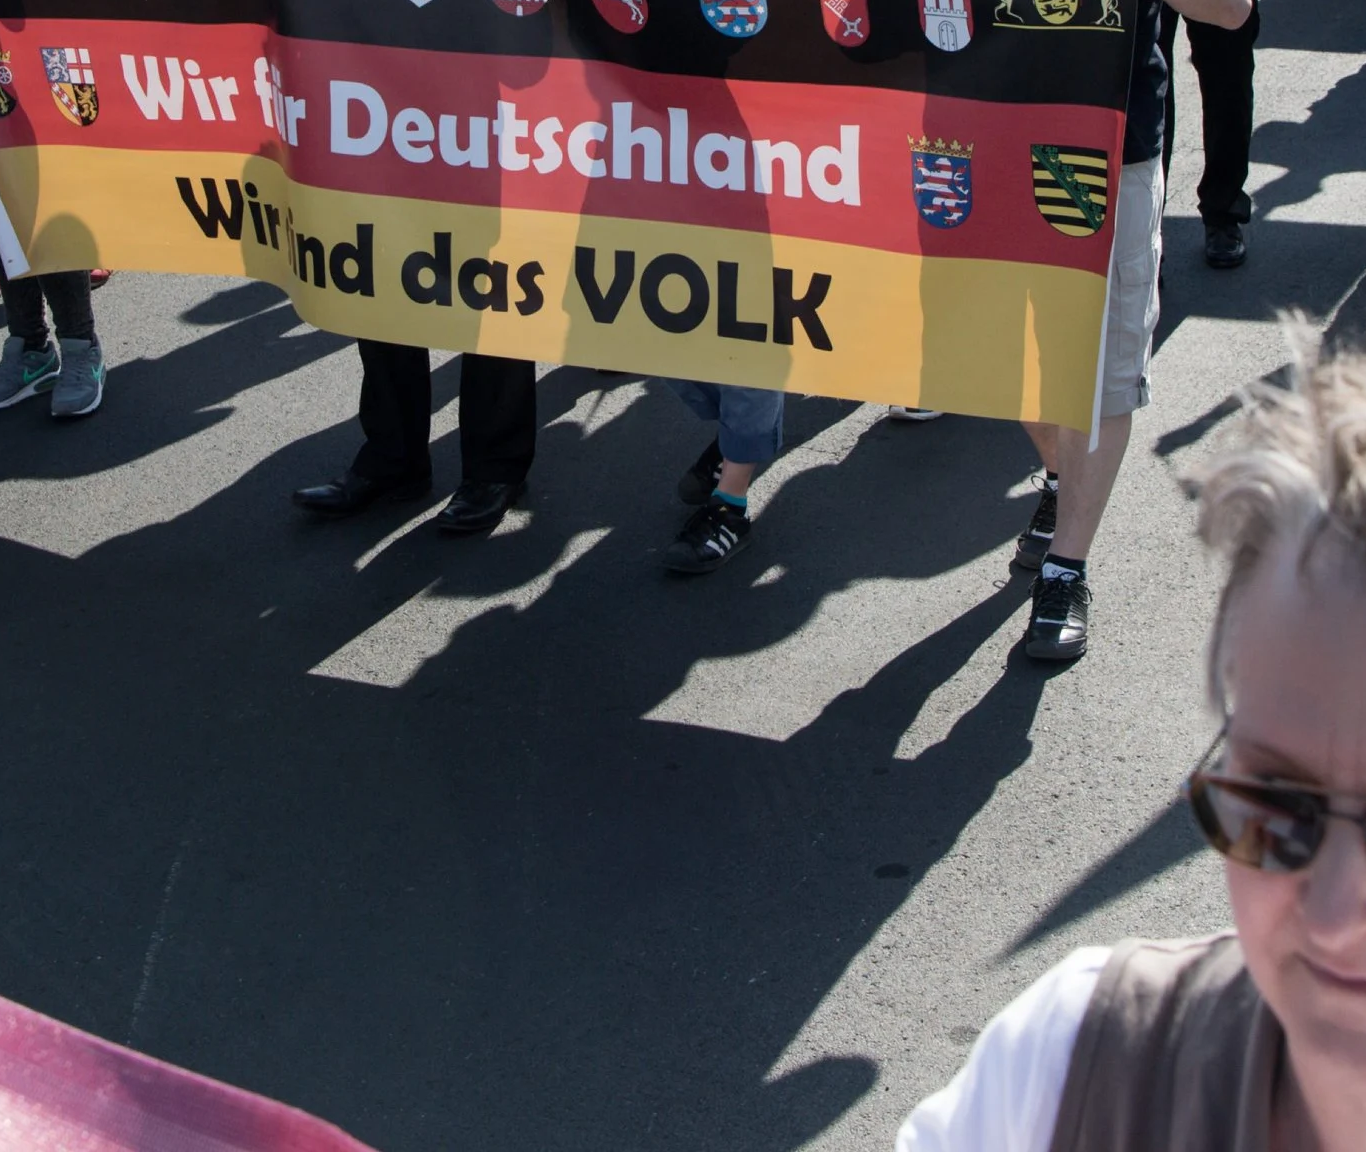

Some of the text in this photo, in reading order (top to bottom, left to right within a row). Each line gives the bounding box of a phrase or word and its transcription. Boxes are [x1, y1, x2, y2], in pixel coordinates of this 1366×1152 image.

[120, 54, 239, 121] Wir
[329, 79, 862, 207] Deutschland
[175, 176, 281, 251] Wir
[401, 232, 545, 316] das
[574, 246, 834, 353] VOLK
